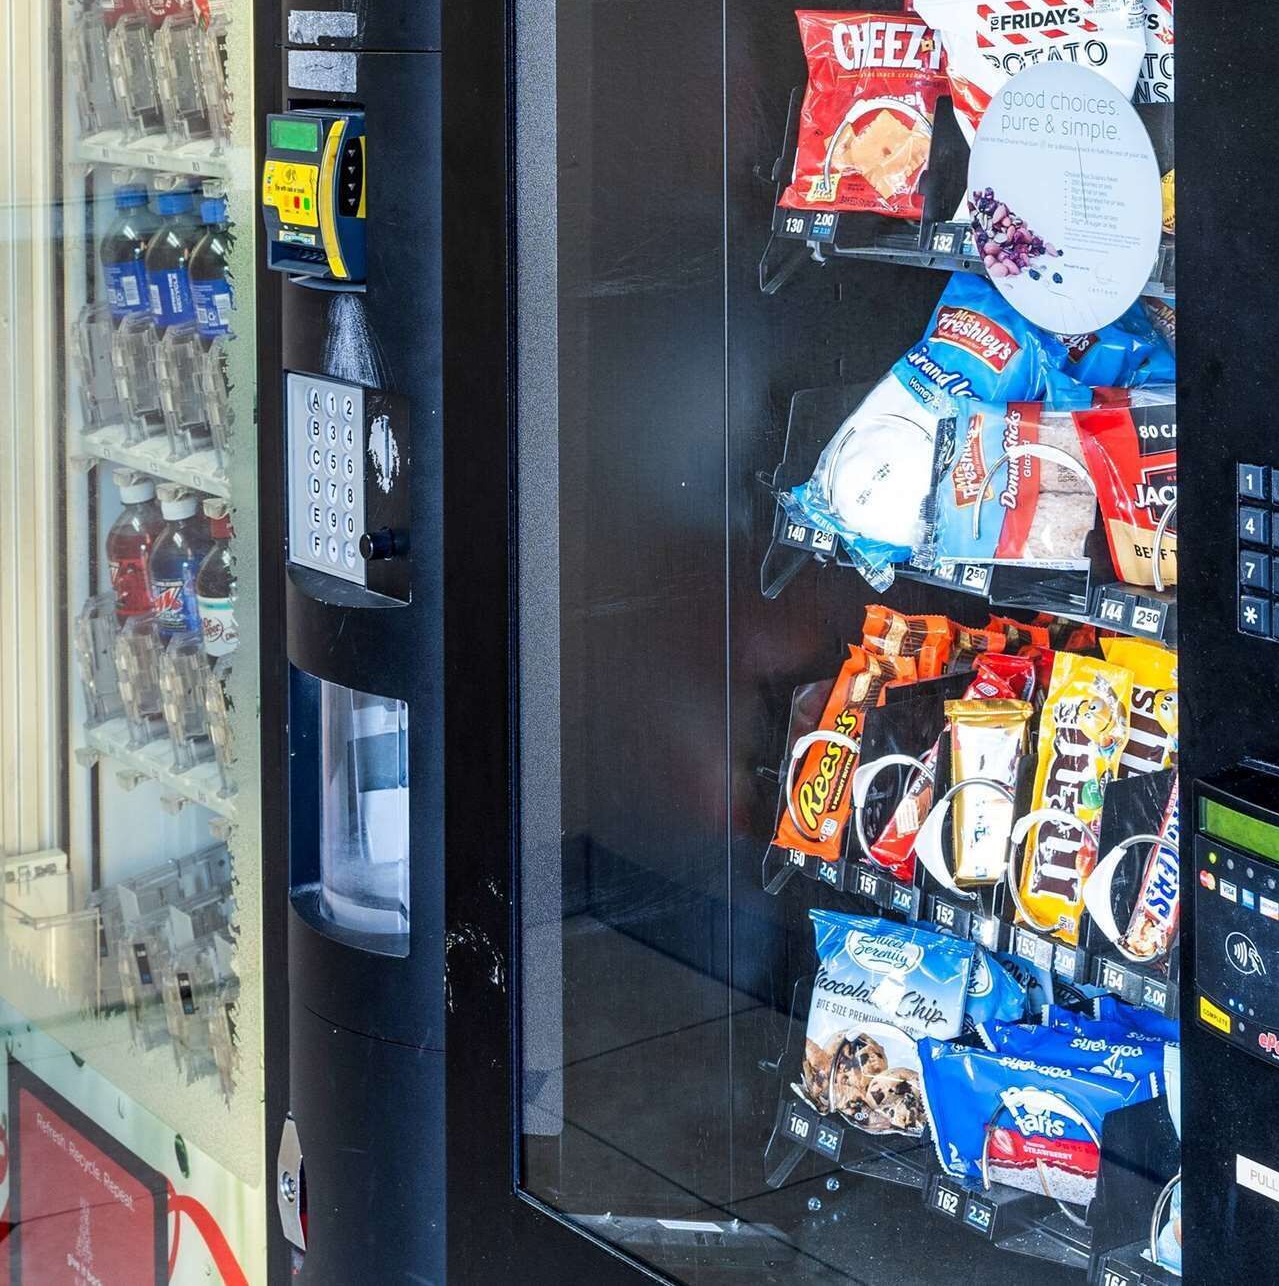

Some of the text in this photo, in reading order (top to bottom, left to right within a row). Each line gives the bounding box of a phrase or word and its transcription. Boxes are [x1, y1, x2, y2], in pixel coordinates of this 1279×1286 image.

[990, 8, 1081, 32] TGI FRIDAYS
[1003, 90, 1120, 115] good choices.
[1001, 114, 1121, 142] pure & simple.
[785, 214, 834, 233] 130 2.00
[933, 235, 953, 251] 132
[939, 313, 1012, 361] Freshley's
[909, 378, 933, 403] Honey
[313, 392, 352, 416] A 1 2
[313, 421, 352, 445] B 3 4
[1139, 425, 1159, 439] 80
[313, 450, 353, 475] C 5 6
[313, 479, 353, 504] D 7 8
[1246, 475, 1253, 490] 1
[314, 507, 353, 534] E 9 0
[1245, 518, 1255, 535] 4
[314, 536, 320, 552] F
[787, 524, 806, 543] 140
[1245, 562, 1256, 578] 7
[1101, 600, 1123, 622] 144
[834, 753, 853, 805] PEANUT BUTTER
[789, 849, 805, 867] 150
[860, 876, 876, 892] 151
[936, 905, 954, 925] 152
[1054, 950, 1075, 972] 2.00
[1102, 967, 1166, 1009] 154 2.00
[816, 999, 847, 1016] BITE SIZE
[895, 991, 947, 1028] Chip
[1202, 1008, 1228, 1026] COMPLETE
[790, 1117, 839, 1151] 160 2.25
[1015, 1114, 1065, 1136] tarts
[1023, 1146, 1072, 1160] STRAWBERRY
[1250, 1168, 1278, 1194] PULL
[937, 1190, 990, 1226] 162 2.25
